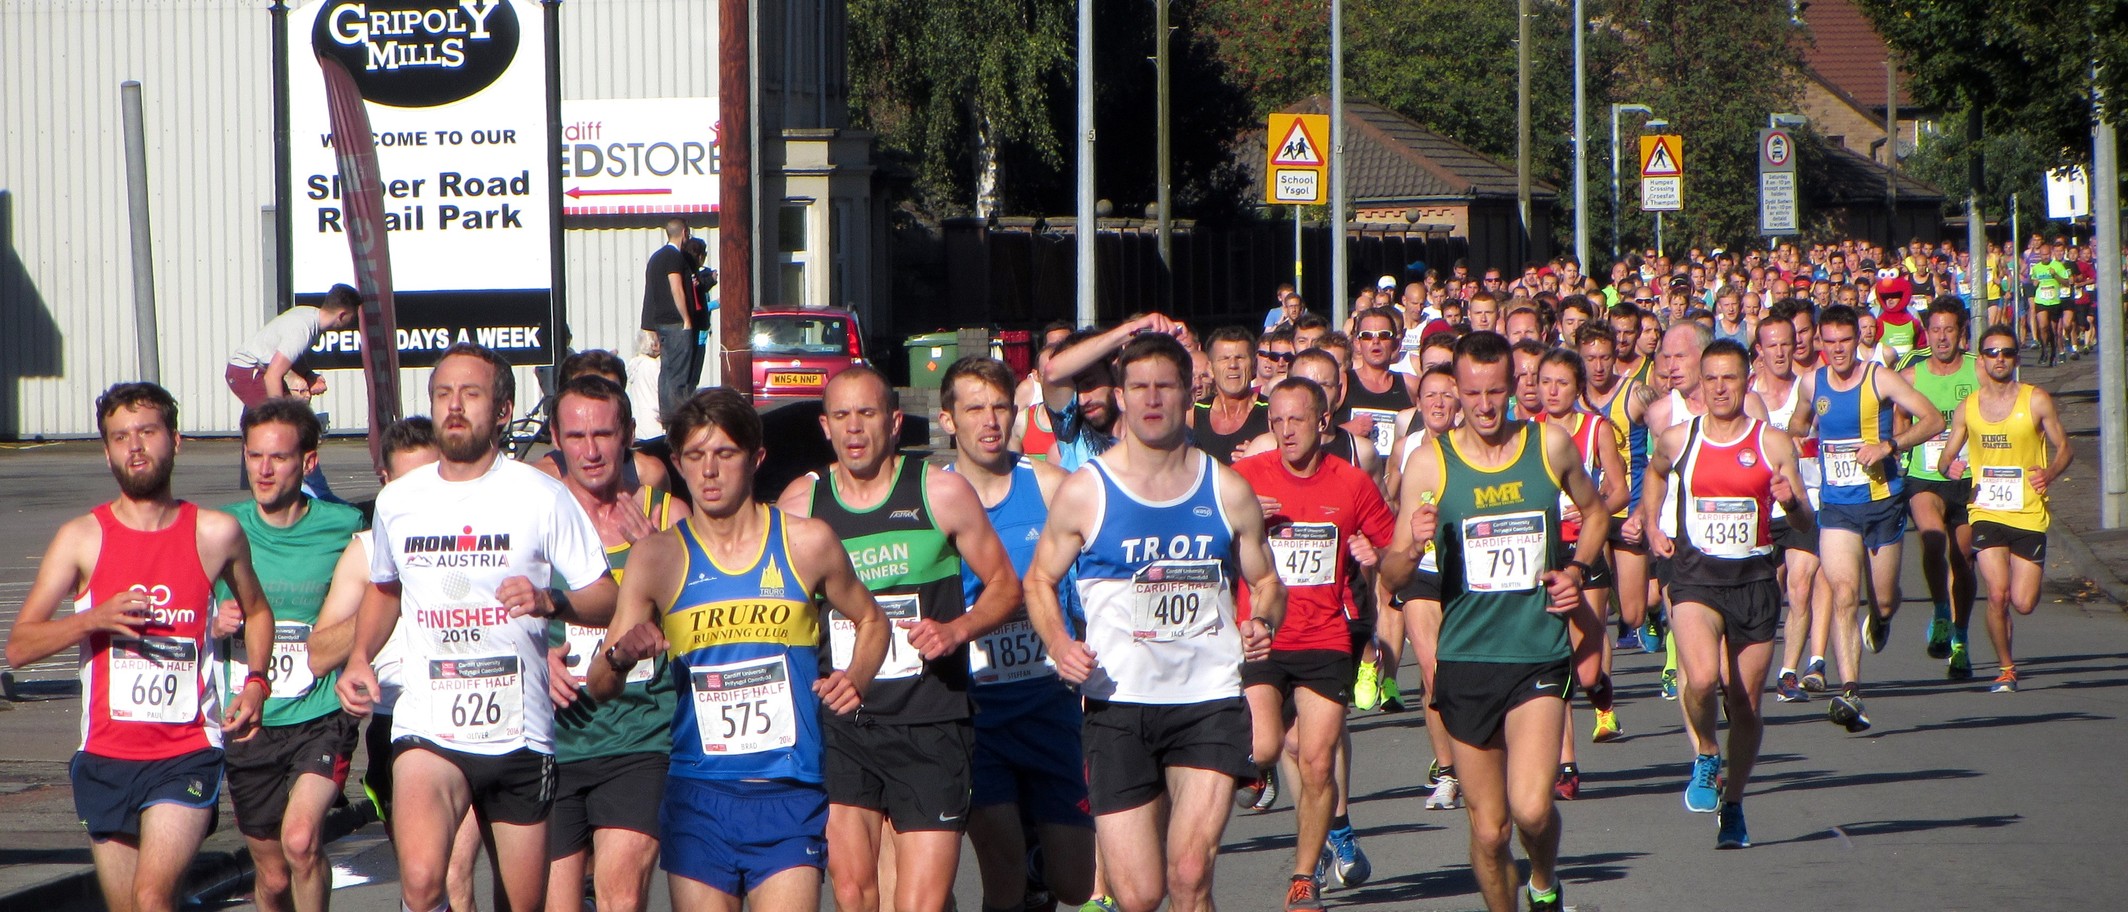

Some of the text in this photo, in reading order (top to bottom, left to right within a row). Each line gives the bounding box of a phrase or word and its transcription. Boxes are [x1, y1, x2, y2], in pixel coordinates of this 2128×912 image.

[328, 0, 501, 45] GRIPOLY
[365, 38, 465, 70] MILLS
[321, 130, 517, 148] WCOME TO OUR
[1088, 130, 1095, 139] 5
[307, 170, 530, 200] Sler Road
[1281, 175, 1313, 184] School
[1284, 186, 1309, 195] Ysgol
[318, 203, 523, 233] Rail Park
[396, 328, 450, 350] DAYS
[456, 329, 472, 345] A
[476, 326, 542, 350] WEEK
[775, 375, 818, 384] WN54 NNP
[1835, 460, 1858, 478] 807
[1989, 485, 2013, 501] 546
[1467, 533, 1543, 549] CARDIFF HALF
[1705, 522, 1748, 545] 4343
[404, 532, 510, 553] IRONMAN
[1121, 535, 1213, 564] T.R.O.T.
[1271, 540, 1334, 548] CARDIFF HALF
[437, 553, 510, 568] AUSTRIA
[1286, 550, 1322, 574] 475
[1487, 547, 1527, 578] 791
[1183, 567, 1206, 575] University
[760, 588, 785, 596] TRURO
[1136, 583, 1185, 594] CARDIFF
[417, 606, 509, 629] FINISHER
[1155, 593, 1200, 626] 409
[690, 604, 791, 632] TRURO
[442, 628, 480, 643] 2016
[570, 627, 607, 636] CARDI
[694, 627, 789, 644] RUNNING CLUB
[985, 631, 1047, 669] 1852
[114, 660, 194, 671] CARDIFF HALF
[481, 666, 504, 674] Caerdydd
[723, 668, 768, 680] Cardiff University
[724, 674, 772, 687] Prifysgol Caerdydd
[131, 673, 178, 706] 669
[431, 675, 517, 691] CARDIFF HALF
[698, 682, 785, 703] CARDIFF HALF
[451, 691, 501, 727] 626
[721, 699, 771, 739] 575
[506, 727, 519, 736] 2016
[740, 742, 758, 751] BRAD
[779, 735, 792, 745] 2016
